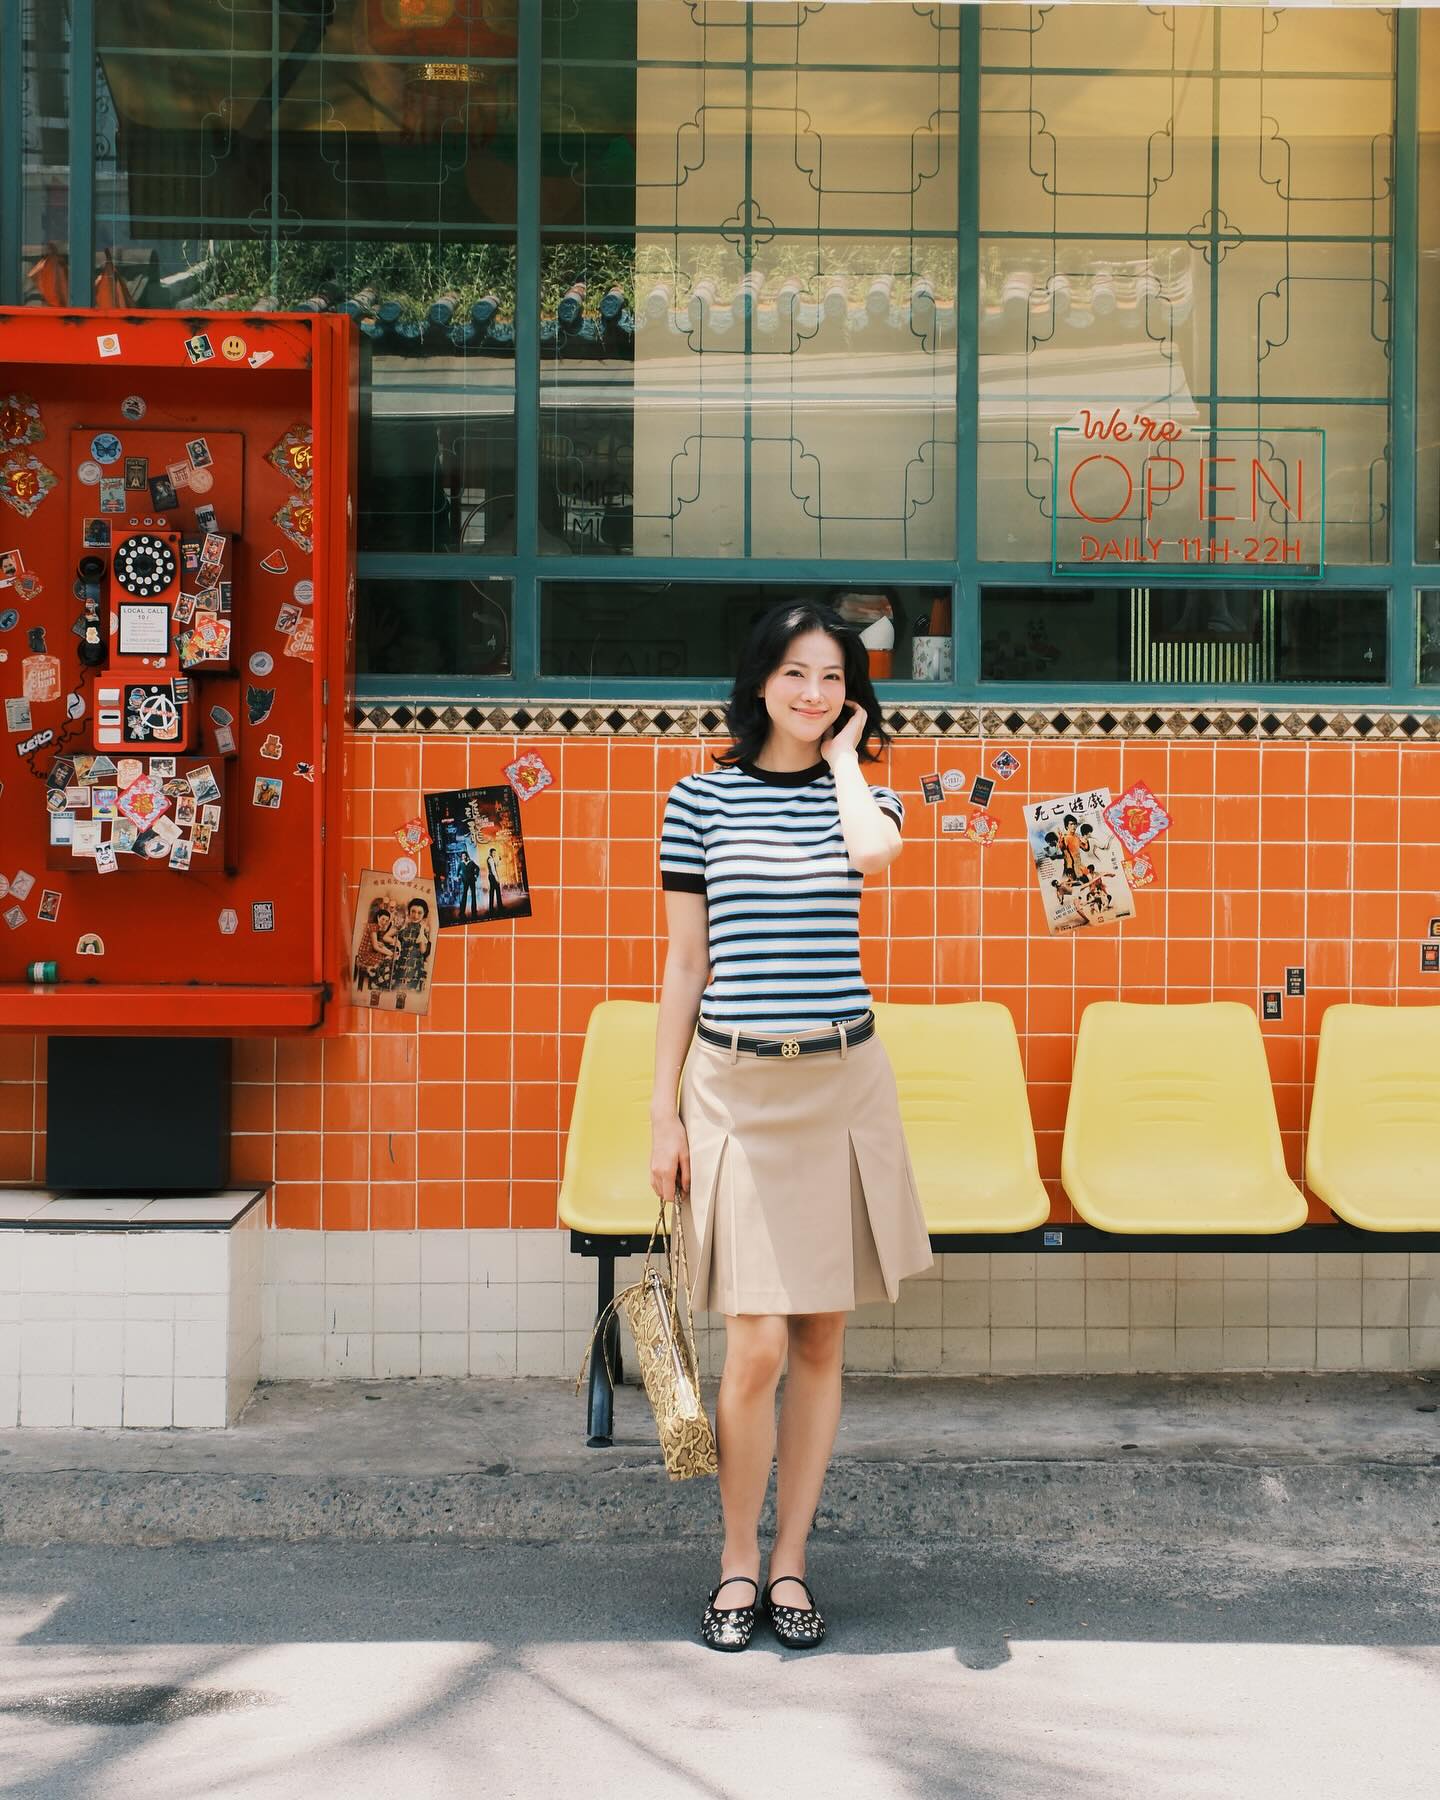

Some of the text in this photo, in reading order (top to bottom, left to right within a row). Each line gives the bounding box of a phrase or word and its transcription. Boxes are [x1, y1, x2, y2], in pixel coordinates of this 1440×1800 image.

[1080, 408, 1182, 442] We're
[1070, 454, 1303, 523] OPEN
[1080, 536, 1163, 562] DAILY
